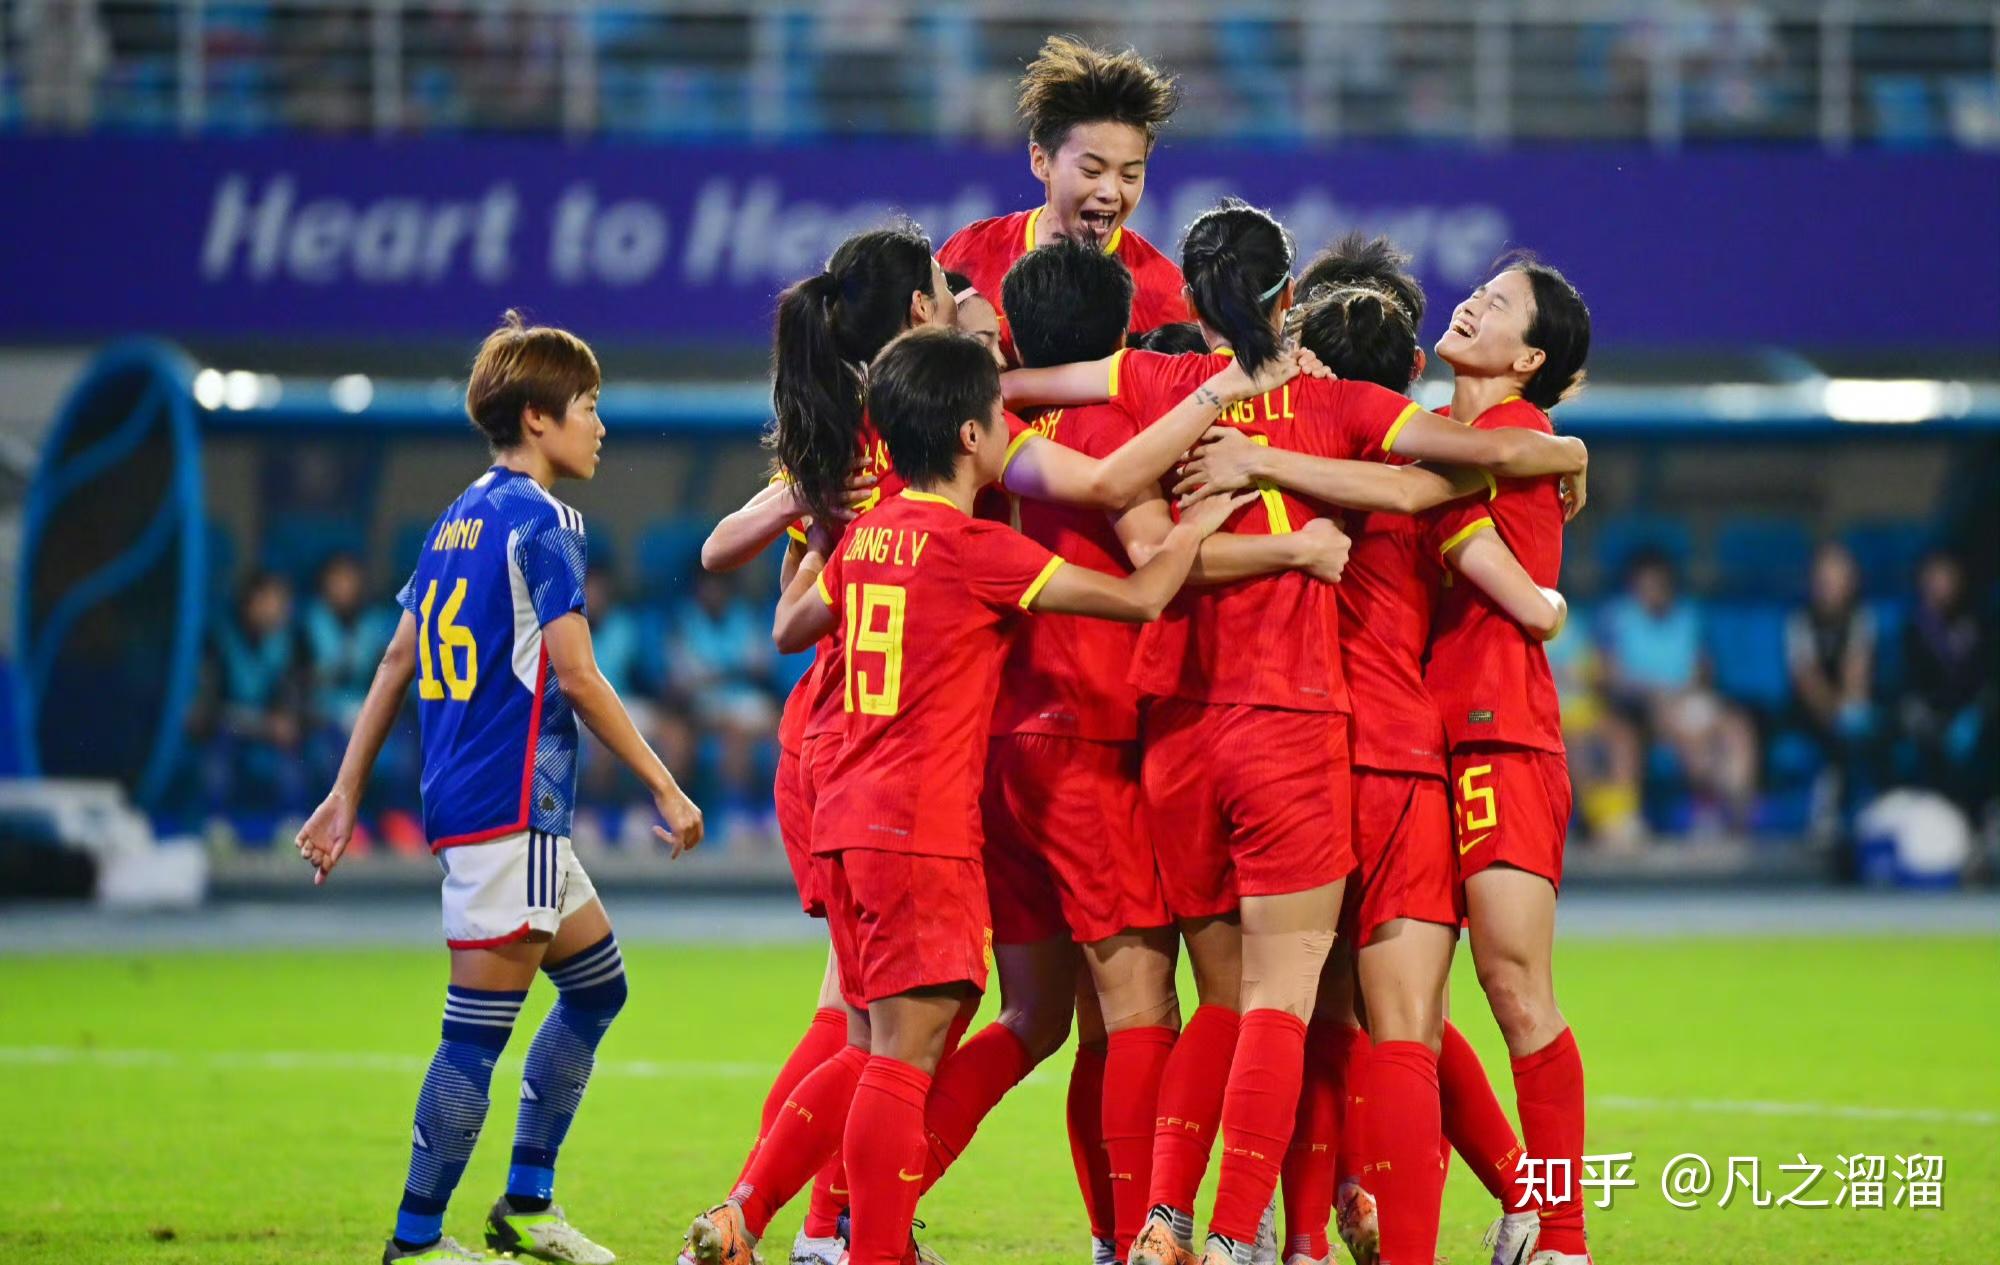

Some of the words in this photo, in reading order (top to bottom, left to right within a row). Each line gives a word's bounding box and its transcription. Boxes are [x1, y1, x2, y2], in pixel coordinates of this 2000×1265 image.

[204, 176, 522, 286] Heart
[550, 182, 668, 286] to
[418, 577, 478, 701] 16
[844, 583, 906, 716] 19
